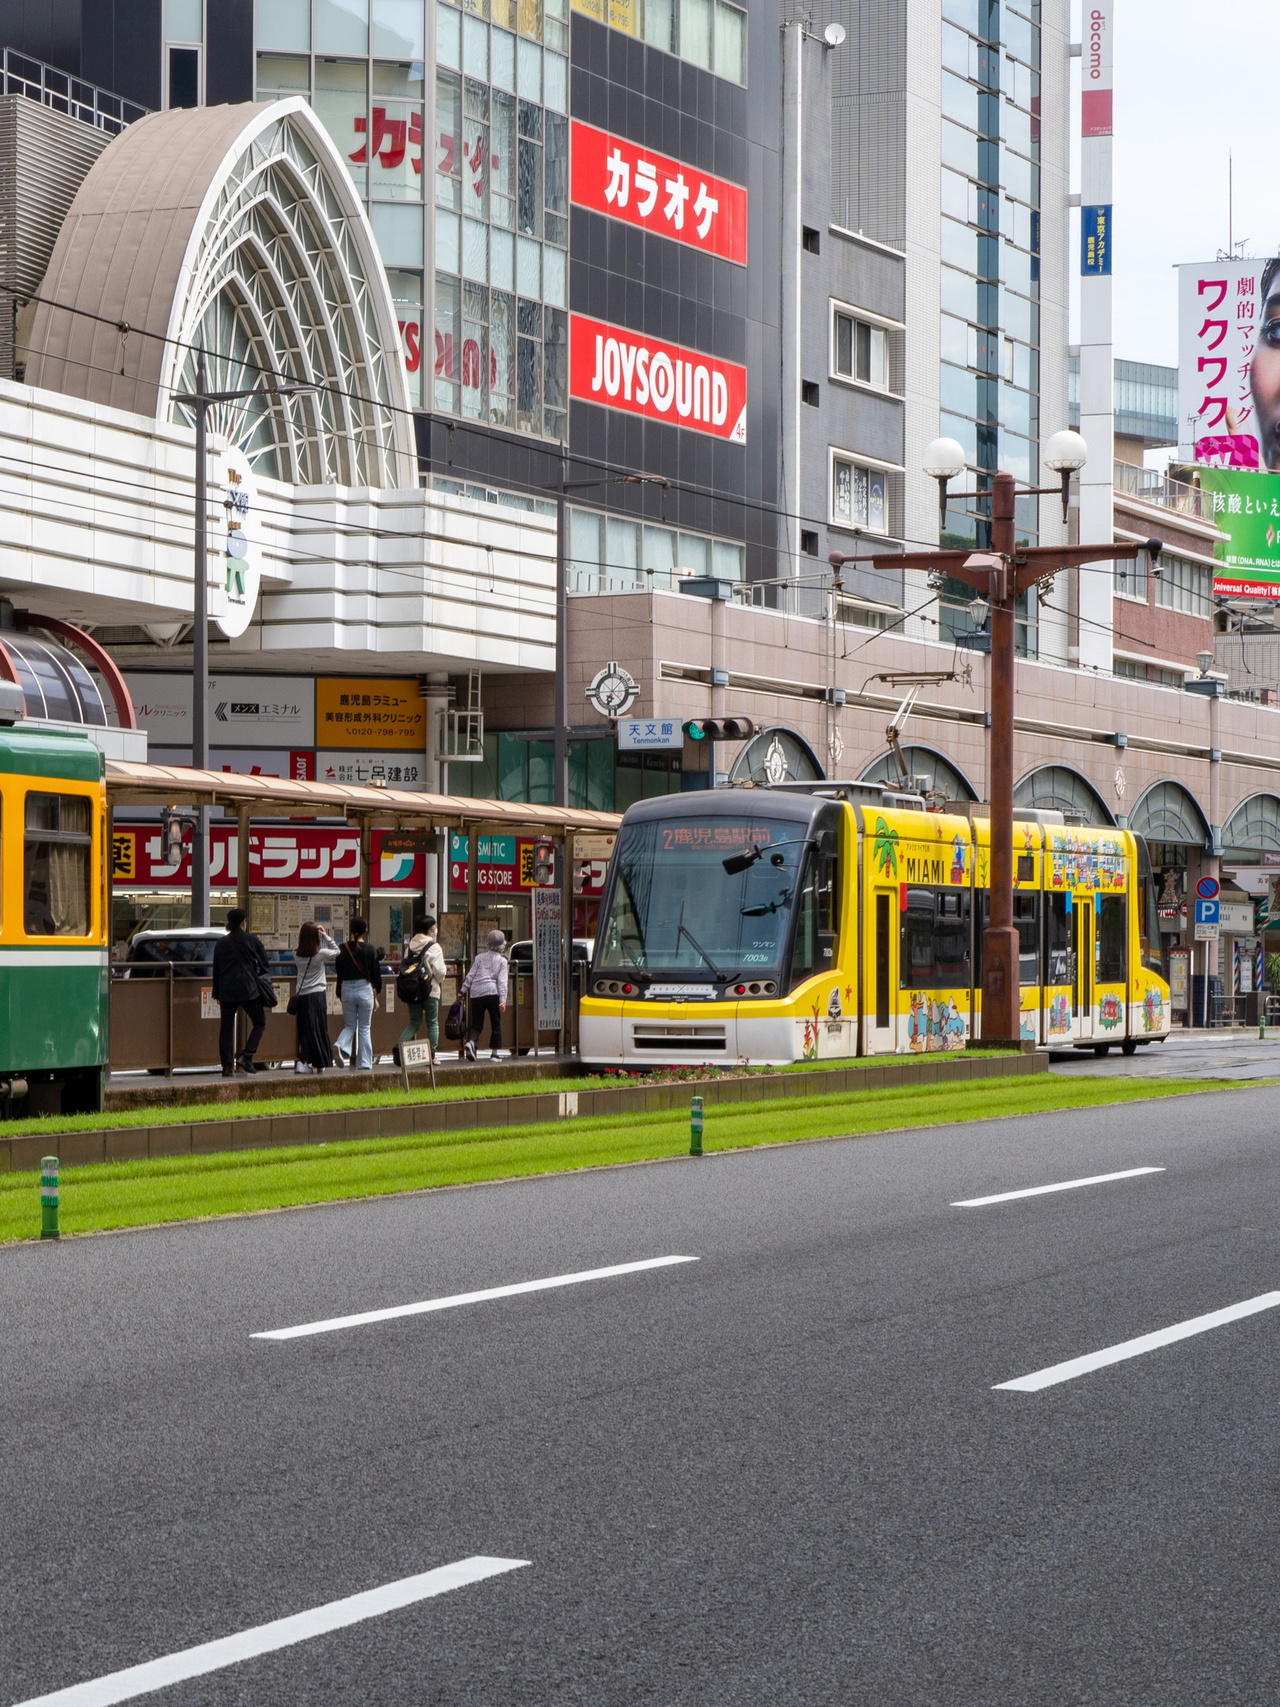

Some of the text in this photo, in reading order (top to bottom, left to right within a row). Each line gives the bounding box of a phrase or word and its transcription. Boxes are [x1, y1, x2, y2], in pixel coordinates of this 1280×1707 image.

[1090, 9, 1105, 80] docomo
[605, 146, 719, 240] カラオケ
[1096, 216, 1106, 273] 東京アカデミー
[1196, 279, 1228, 429] ワクワク
[1236, 277, 1255, 426] 劇的マッチング
[591, 334, 729, 426] JOYSOUND
[735, 423, 746, 440] 4F
[340, 694, 408, 707] 鹿児島ラミュー
[325, 711, 422, 724] 美容形成外科クリニック
[629, 722, 673, 736] 天文館
[352, 728, 415, 736] 0120-798-795
[355, 766, 418, 782] 七呂建設
[663, 826, 771, 850] 2 鹿児島駅前
[907, 857, 944, 884] MIAMI
[1202, 902, 1215, 921] P
